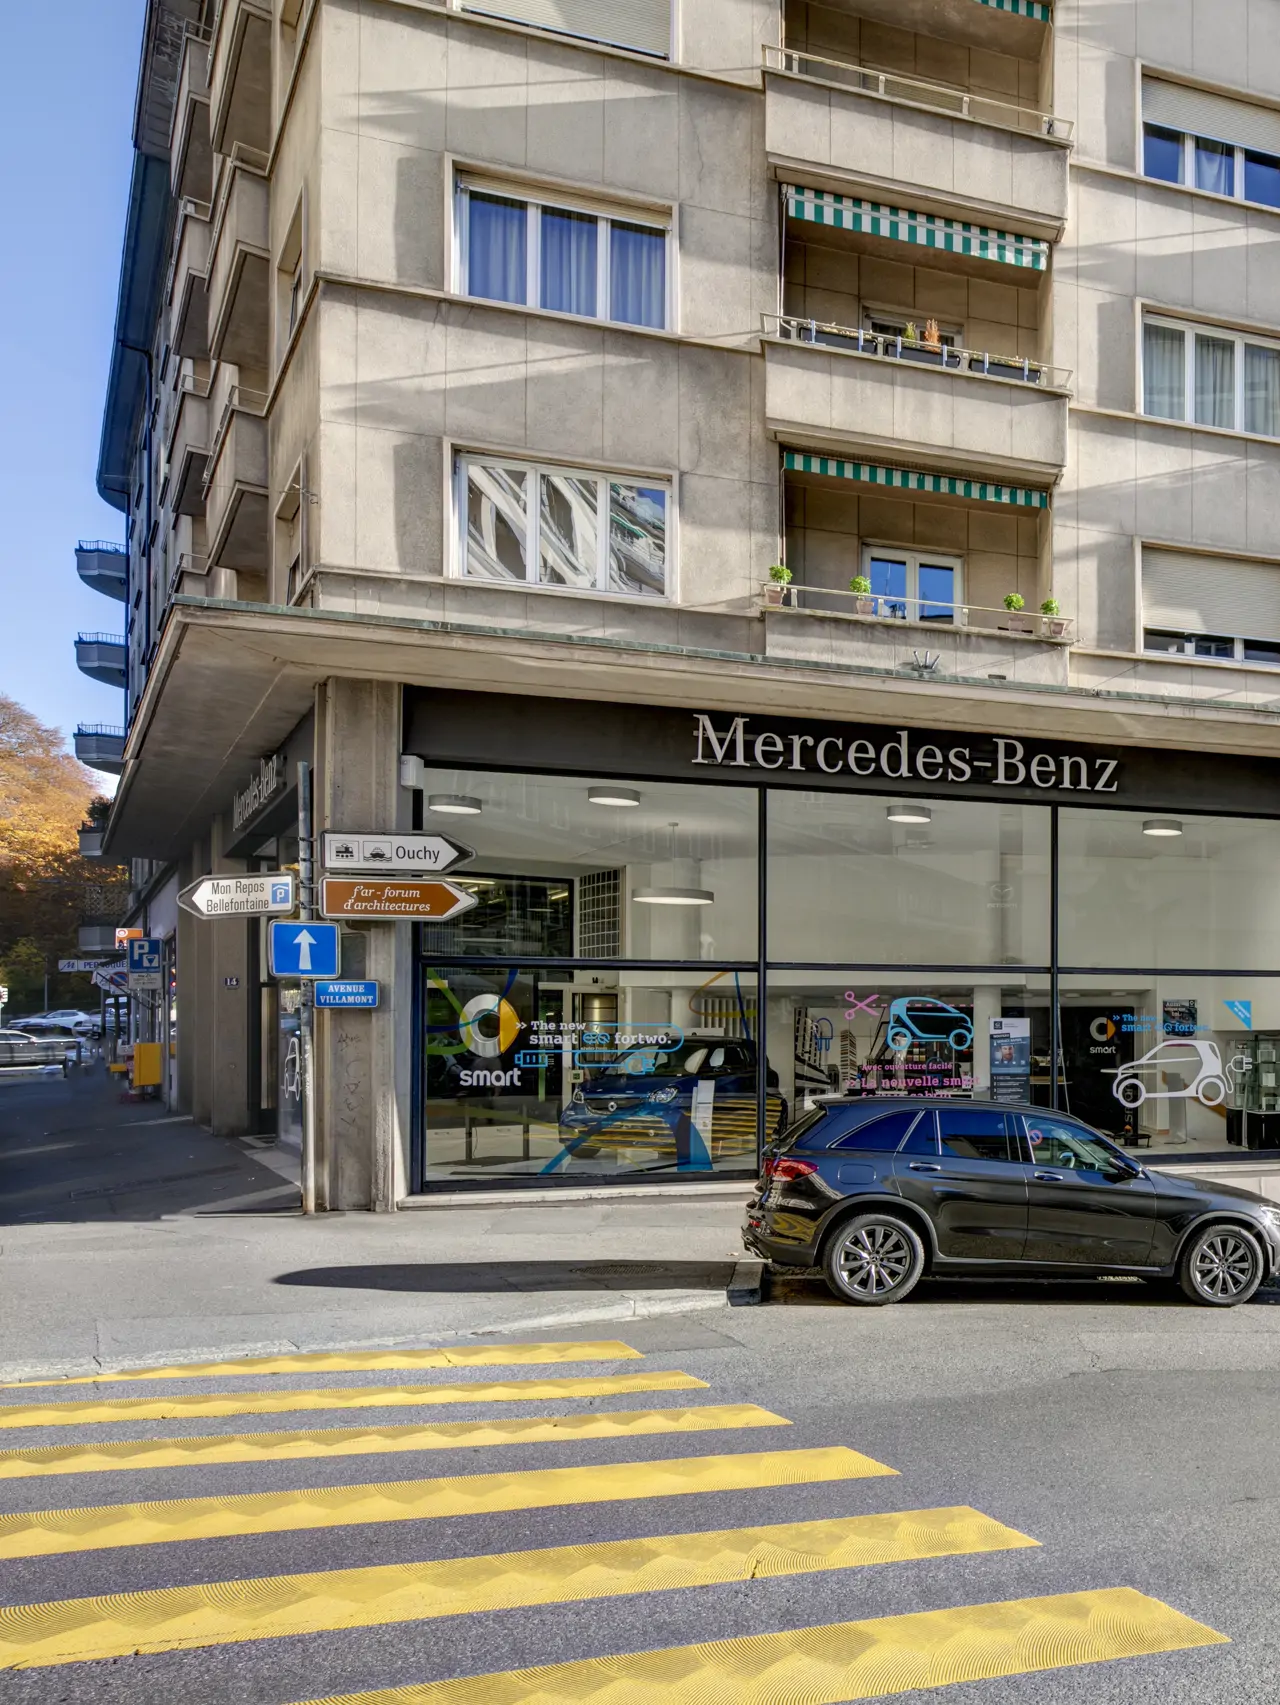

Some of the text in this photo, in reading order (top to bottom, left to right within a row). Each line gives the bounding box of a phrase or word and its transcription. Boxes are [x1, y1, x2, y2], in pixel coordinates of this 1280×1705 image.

[692, 713, 1119, 792] Mercedes-Benz
[396, 846, 440, 863] Ouchy
[211, 882, 265, 897] Mon Repos
[352, 886, 375, 898] f'ar
[383, 887, 421, 898] forum
[207, 898, 269, 912] Bellefontaine
[344, 899, 431, 911] d'architectures
[133, 941, 149, 960] P
[226, 978, 237, 987] 14
[328, 984, 365, 994] AVENUE
[320, 995, 374, 1004] VILLAMONT
[1122, 1014, 1138, 1022] The
[531, 1021, 586, 1030] The new
[1121, 1024, 1151, 1032] smart
[529, 1033, 578, 1044] smart
[614, 1032, 671, 1044] fortwo.
[1090, 1046, 1117, 1054] smart
[861, 1063, 882, 1071] Avec
[459, 1067, 522, 1087] smart
[861, 1077, 877, 1088] La
[881, 1076, 940, 1087] nouvelle
